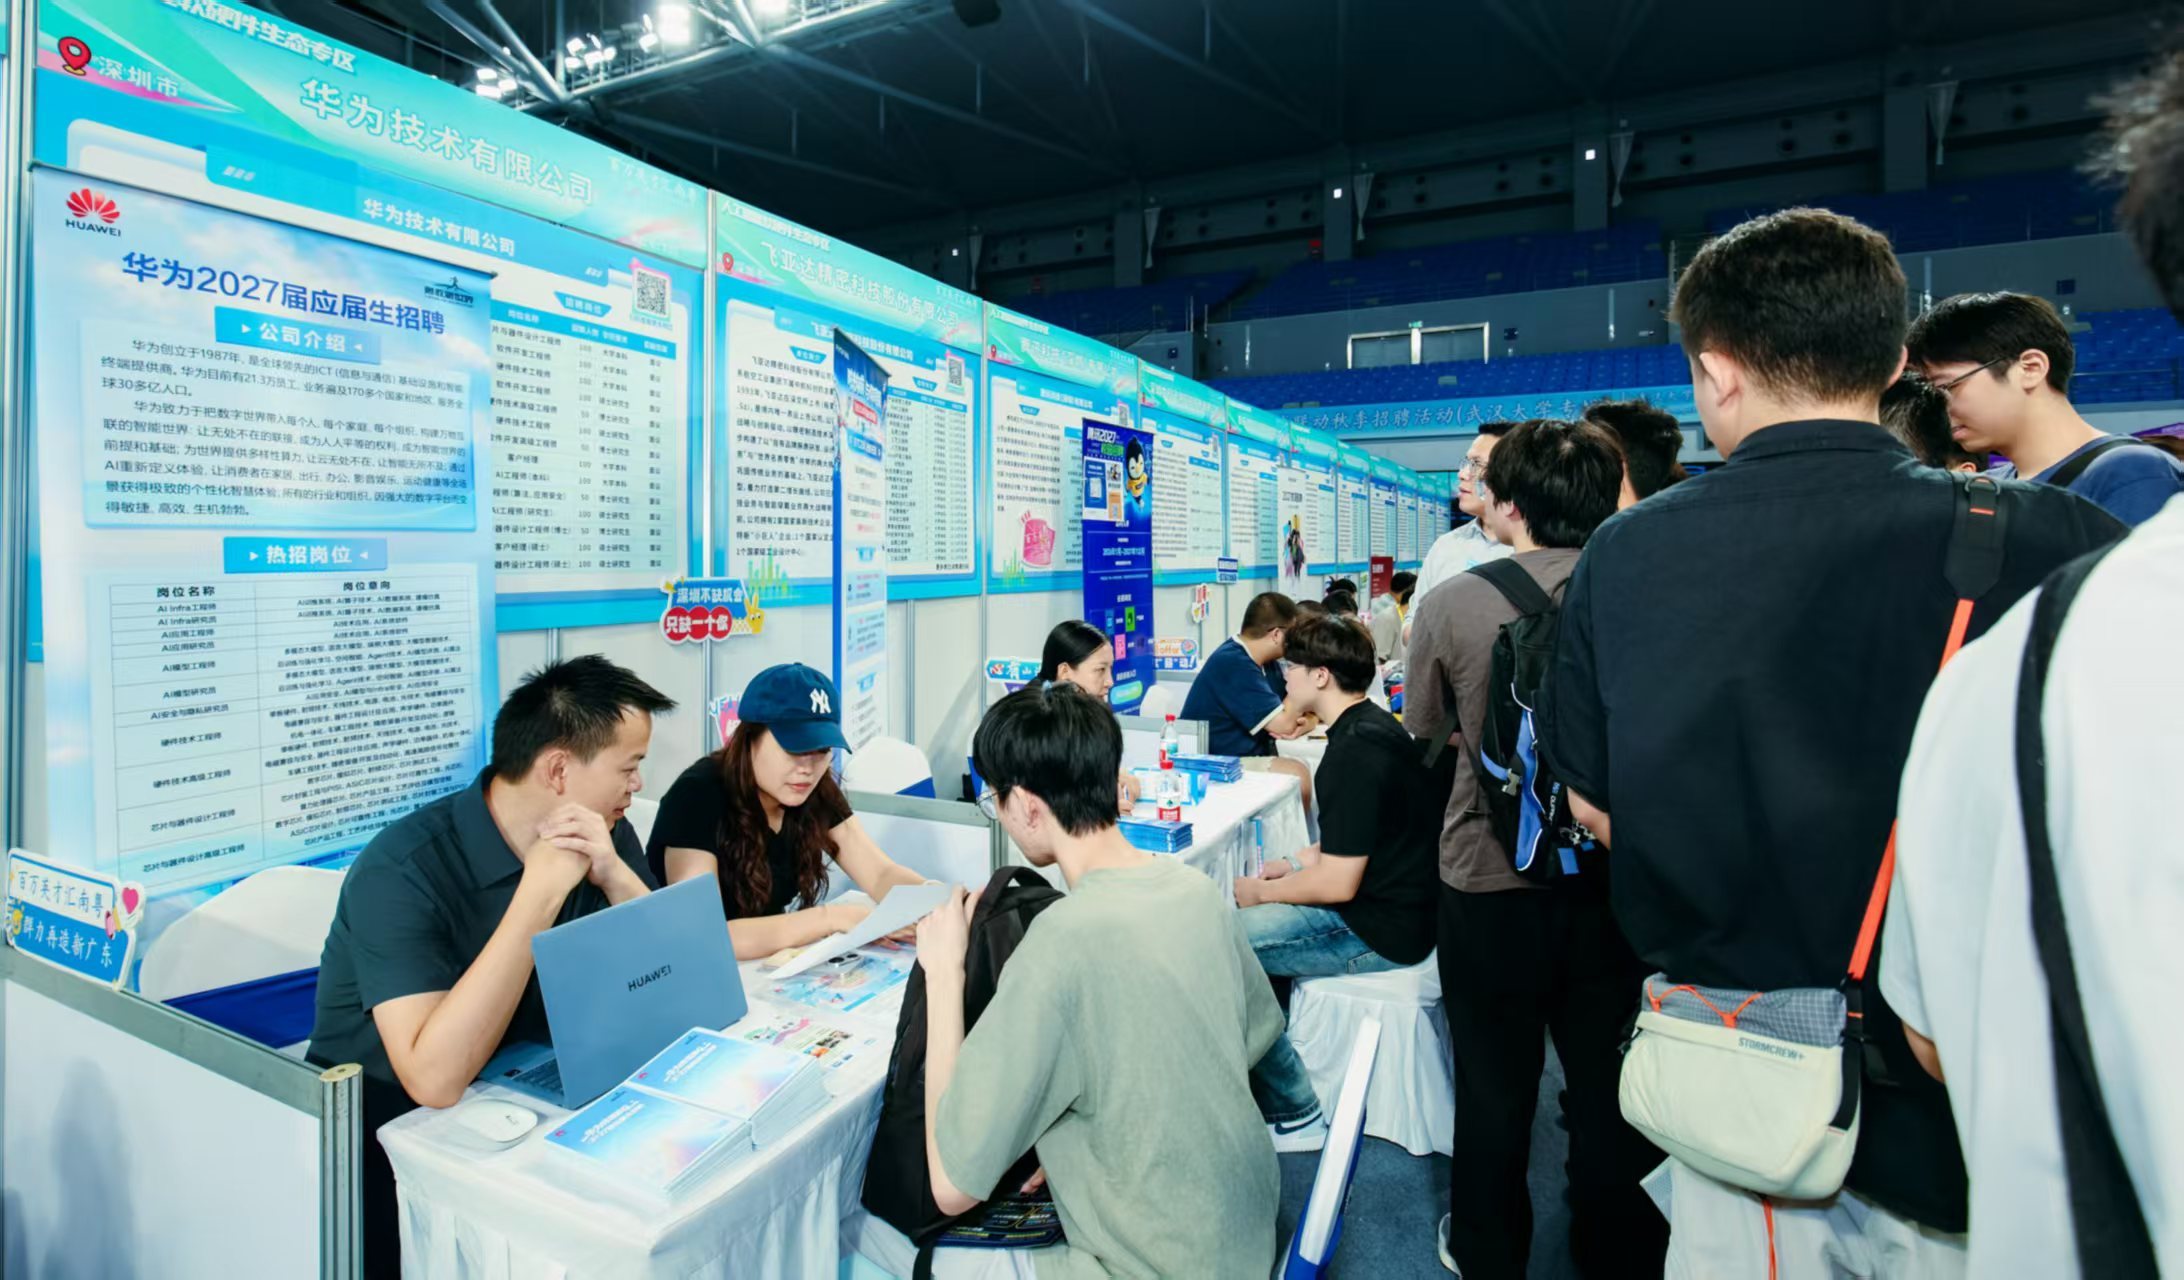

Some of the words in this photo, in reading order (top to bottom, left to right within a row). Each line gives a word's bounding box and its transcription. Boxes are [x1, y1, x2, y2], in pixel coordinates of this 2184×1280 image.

[164, 0, 357, 72] 软硬件生态专区
[98, 56, 179, 98] 深圳市
[301, 78, 593, 205] 华为技术有限公司
[65, 219, 121, 237] HUAWEI
[363, 198, 515, 258] 华为技术有限公司
[121, 251, 446, 335] 华为2027届应届生招聘
[760, 241, 959, 326] 飞亚达精密科技股份有限公司
[258, 323, 346, 353] 公司介绍
[102, 377, 193, 397] 球30多亿人口。
[266, 545, 352, 565] 热招岗位
[156, 585, 215, 598] 岗位名称
[343, 580, 391, 591] 岗位意向
[666, 615, 728, 634] 只缺一个你
[809, 688, 832, 714] NY
[160, 732, 222, 747] 硬件技术工程师
[18, 871, 103, 918] 百万英才汇南粤
[23, 915, 113, 968] 群力再造新广东
[627, 964, 672, 992] HUAWEI
